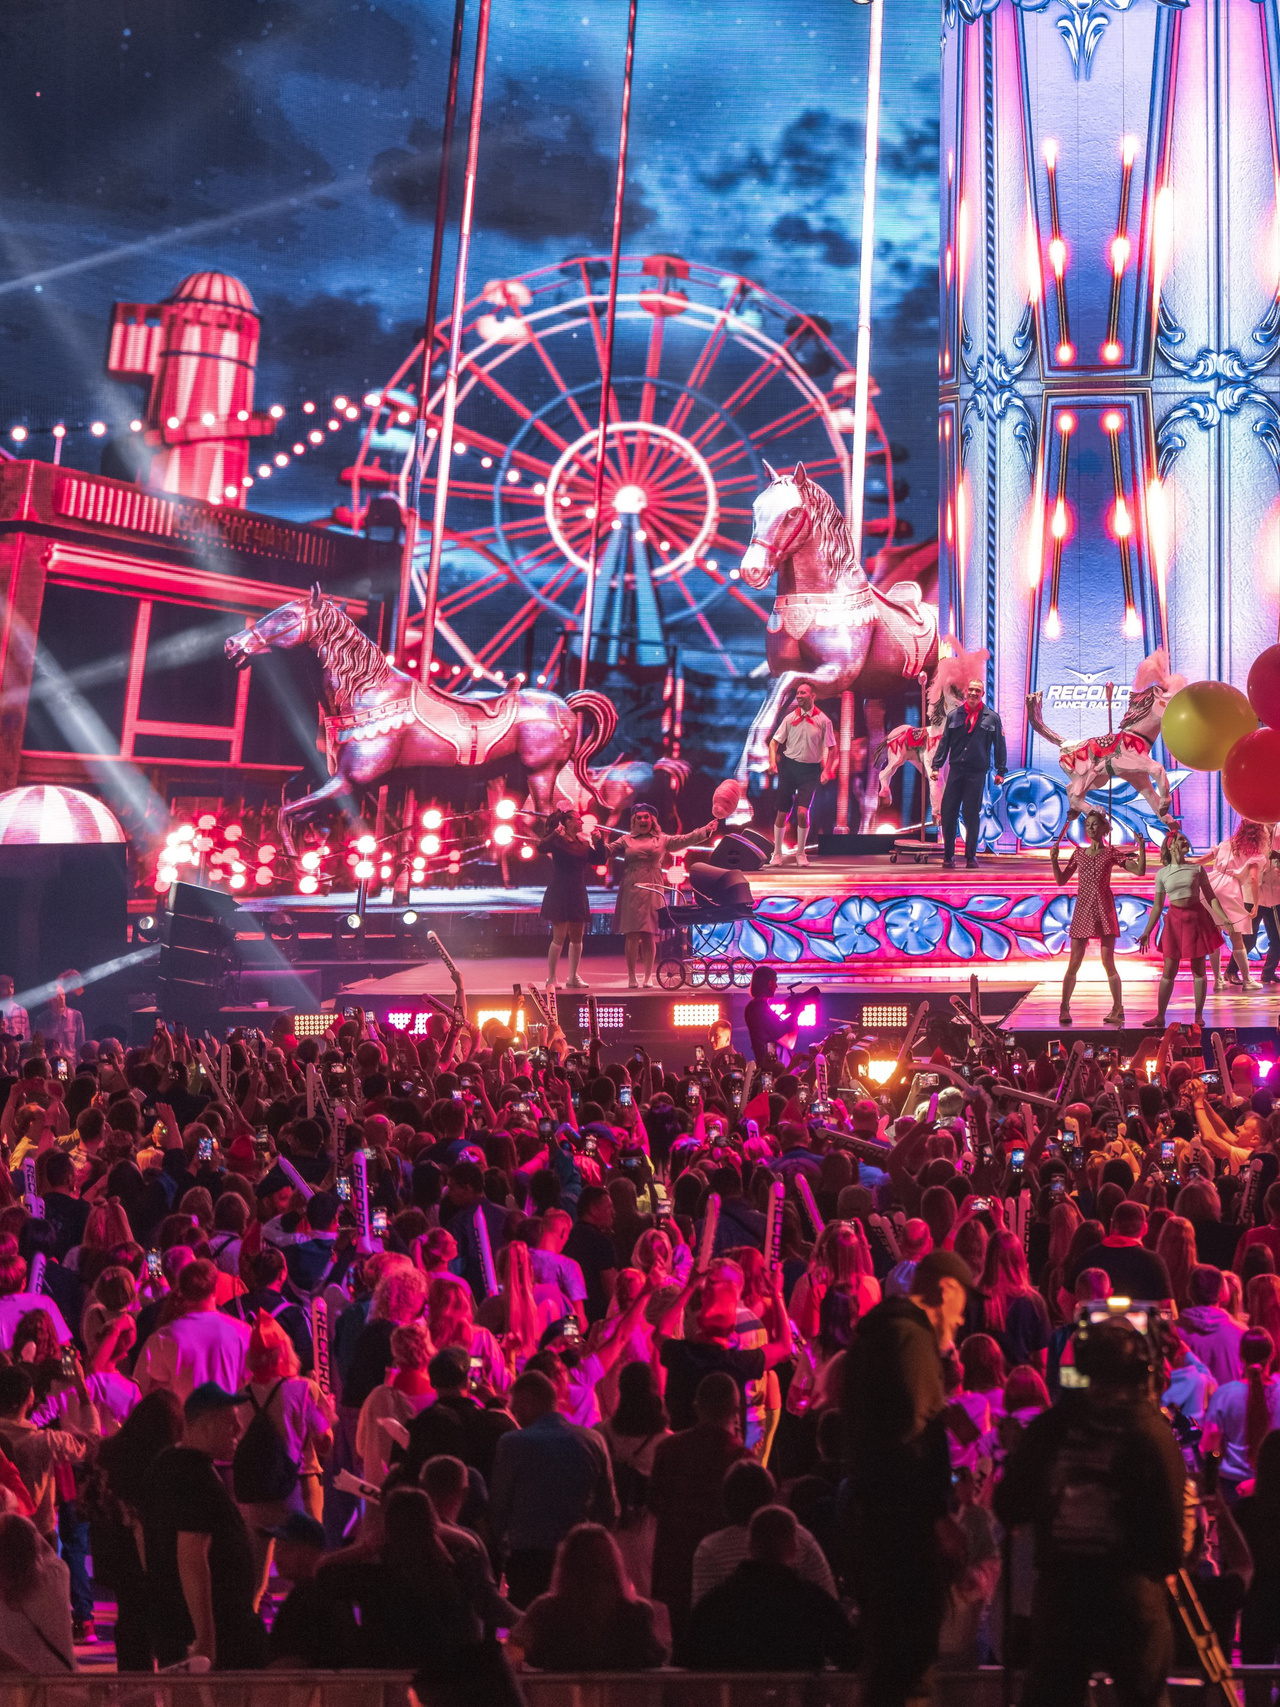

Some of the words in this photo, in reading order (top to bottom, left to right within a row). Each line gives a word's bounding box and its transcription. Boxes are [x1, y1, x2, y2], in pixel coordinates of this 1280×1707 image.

[1047, 685, 1133, 700] RECORD
[429, 936, 456, 974] RECORD
[954, 1001, 994, 1039] RECORD
[818, 1063, 828, 1100] RECO
[25, 1164, 37, 1195] REC
[352, 1163, 367, 1236] RECORD
[769, 1197, 784, 1272] RECORD
[315, 1310, 331, 1395] RECORD
